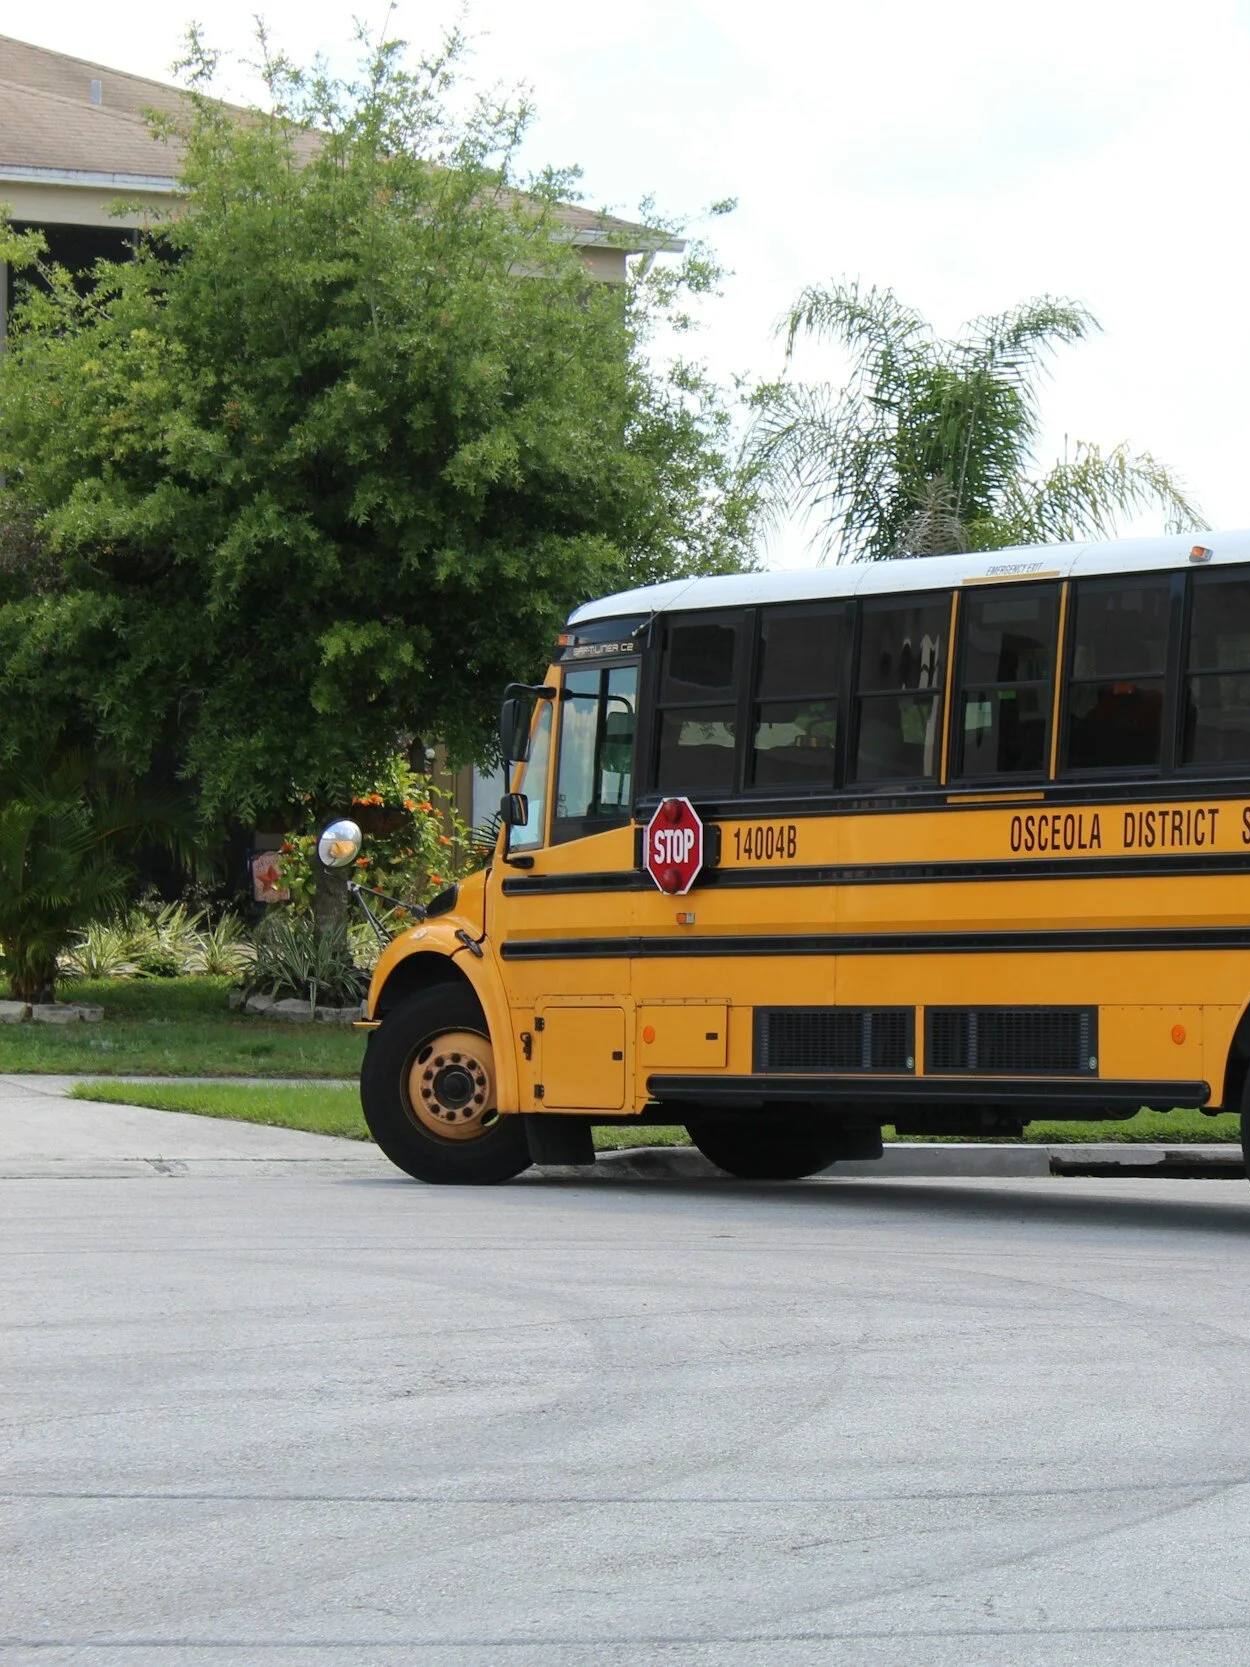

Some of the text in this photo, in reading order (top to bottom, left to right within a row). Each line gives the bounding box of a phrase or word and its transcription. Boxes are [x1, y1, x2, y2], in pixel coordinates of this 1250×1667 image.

[985, 562, 1044, 576] EMERGENCY EXIT
[620, 642, 634, 652] C2
[654, 828, 695, 864] STOP
[734, 825, 797, 861] 14004B
[1010, 813, 1102, 852] OSCEOLA
[1123, 808, 1219, 848] DISTRICT
